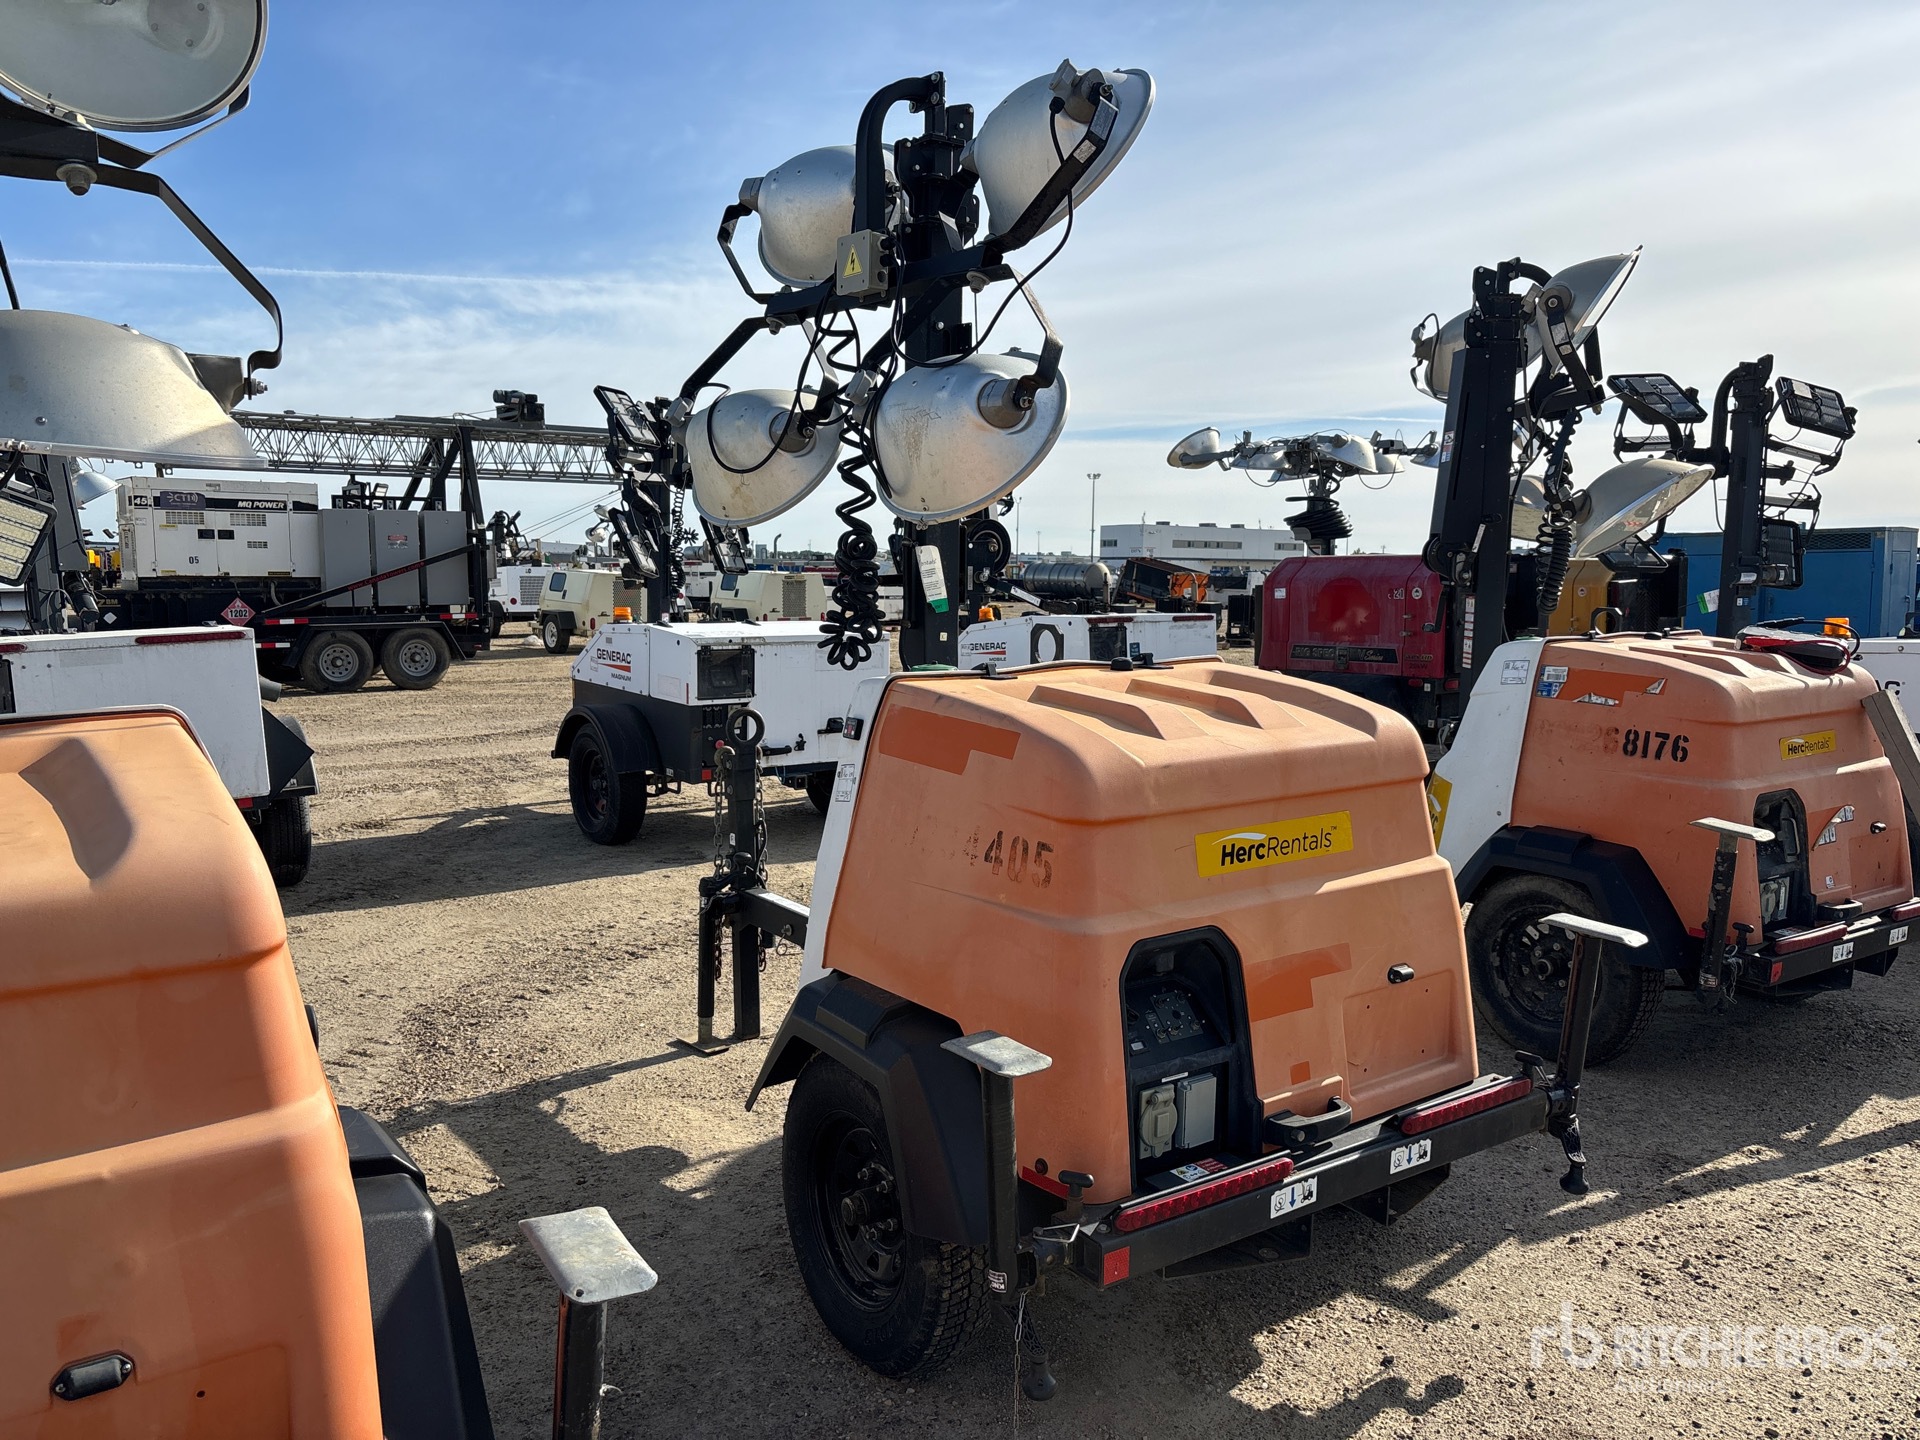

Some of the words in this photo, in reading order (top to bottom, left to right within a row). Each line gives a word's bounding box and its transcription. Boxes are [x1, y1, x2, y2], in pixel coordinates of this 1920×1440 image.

[253, 501, 285, 509] POWER
[188, 556, 200, 565] 05
[229, 609, 248, 618] 1202
[969, 641, 1007, 651] GENERAC
[596, 648, 632, 665] GENERAC
[611, 673, 632, 682] MAGNUM
[1787, 737, 1830, 756] HercRentals
[1220, 827, 1333, 867] HercRentals
